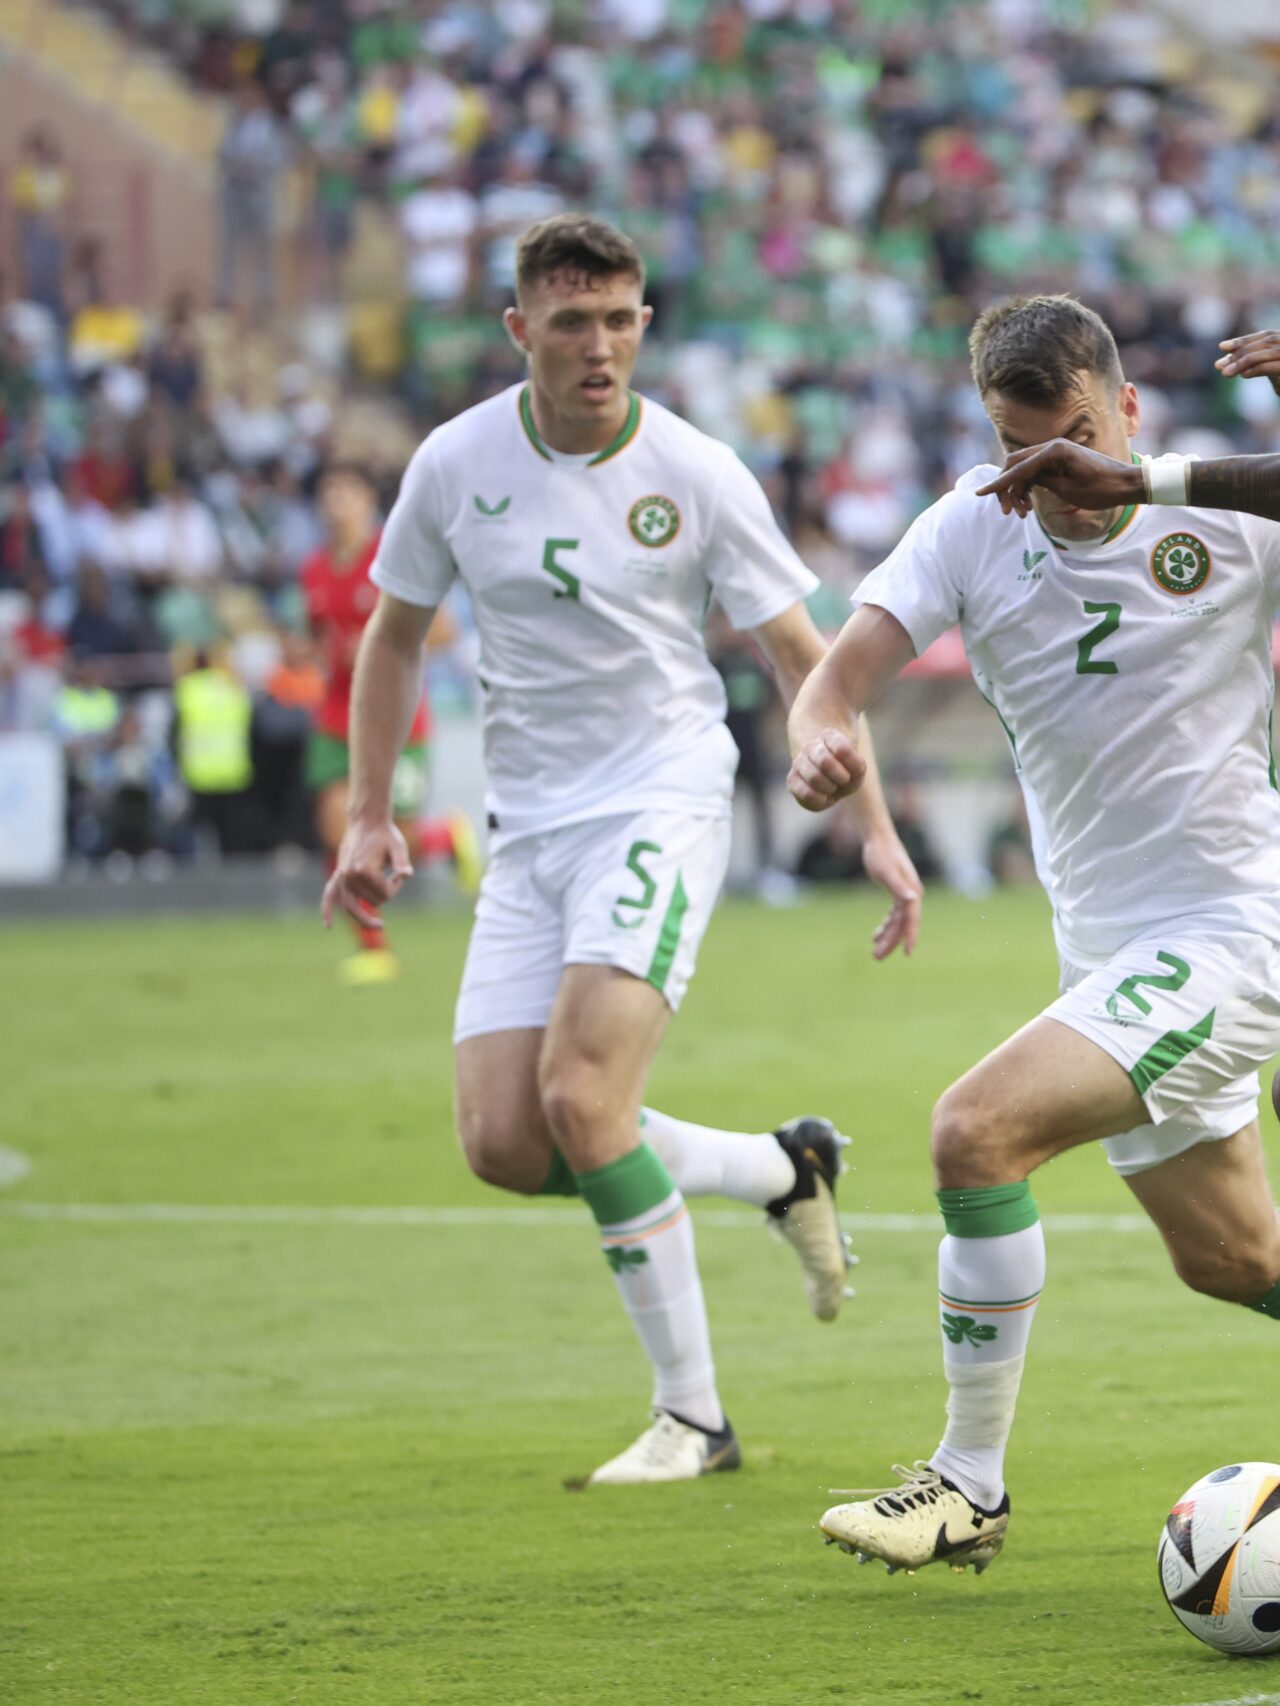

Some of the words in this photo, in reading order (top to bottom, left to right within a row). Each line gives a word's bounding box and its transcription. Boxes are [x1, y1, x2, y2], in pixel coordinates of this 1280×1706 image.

[542, 538, 580, 601] 5
[1155, 535, 1201, 561] IRELAND
[1076, 600, 1122, 674] 2
[615, 840, 663, 909] 5
[1115, 950, 1191, 1016] 2
